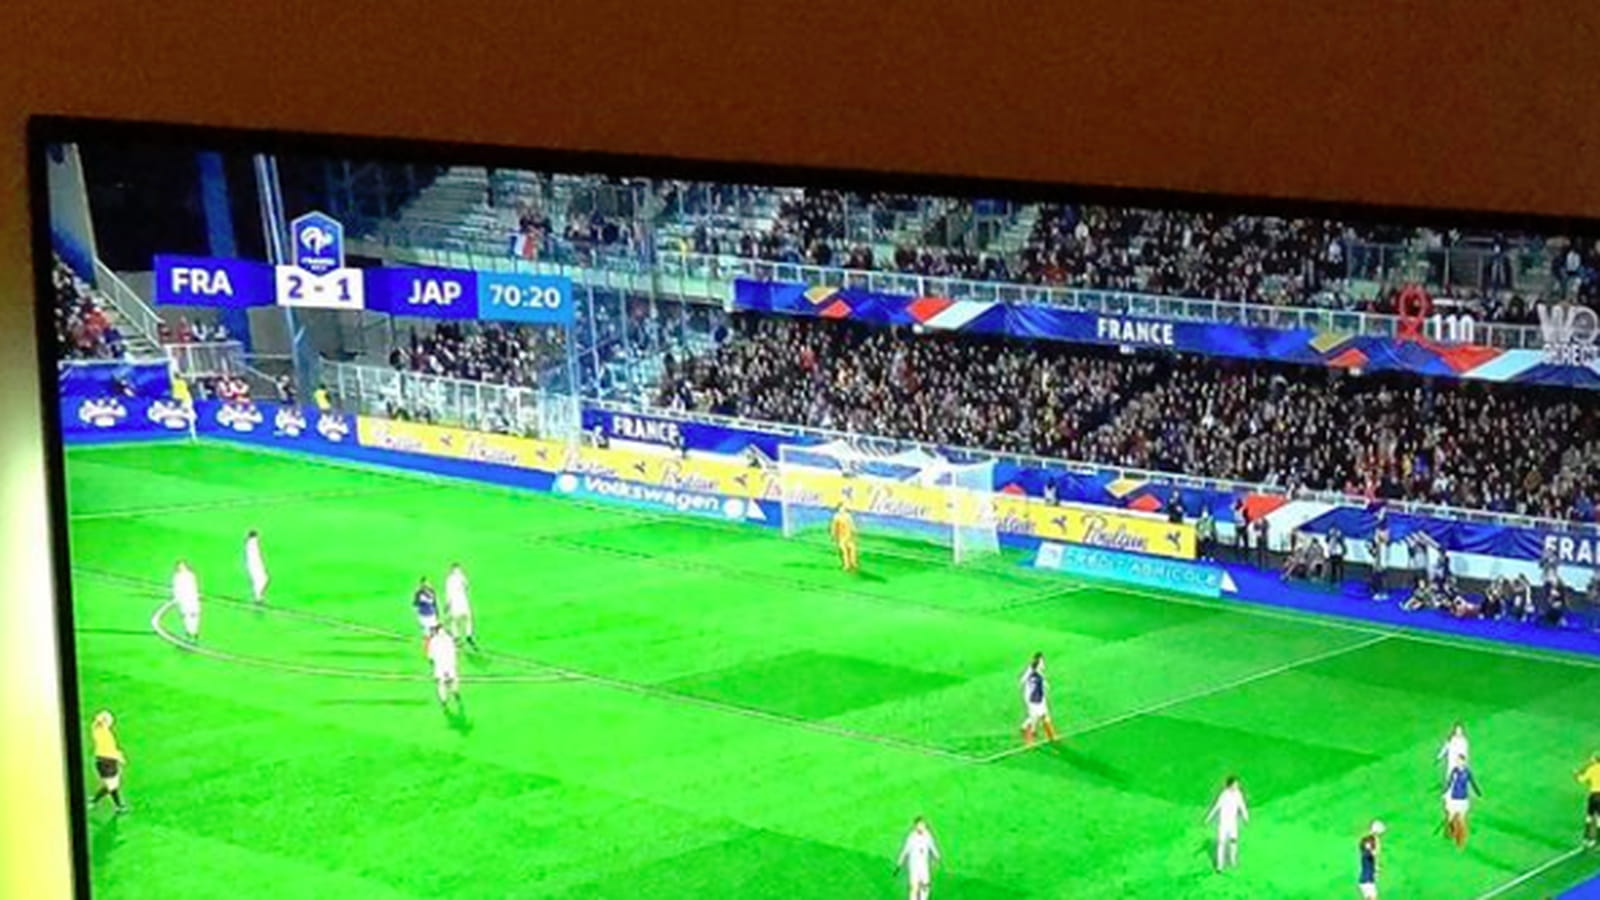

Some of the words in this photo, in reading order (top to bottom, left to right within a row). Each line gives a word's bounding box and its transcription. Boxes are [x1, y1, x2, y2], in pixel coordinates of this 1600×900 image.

[170, 267, 233, 297] FRA
[288, 274, 303, 299] 2
[337, 277, 351, 301] 1
[407, 278, 462, 306] JAP
[489, 283, 561, 309] 70:20
[1097, 316, 1175, 346] FRANCE
[612, 415, 681, 445] FRANCE
[584, 474, 720, 511] Volkswagen
